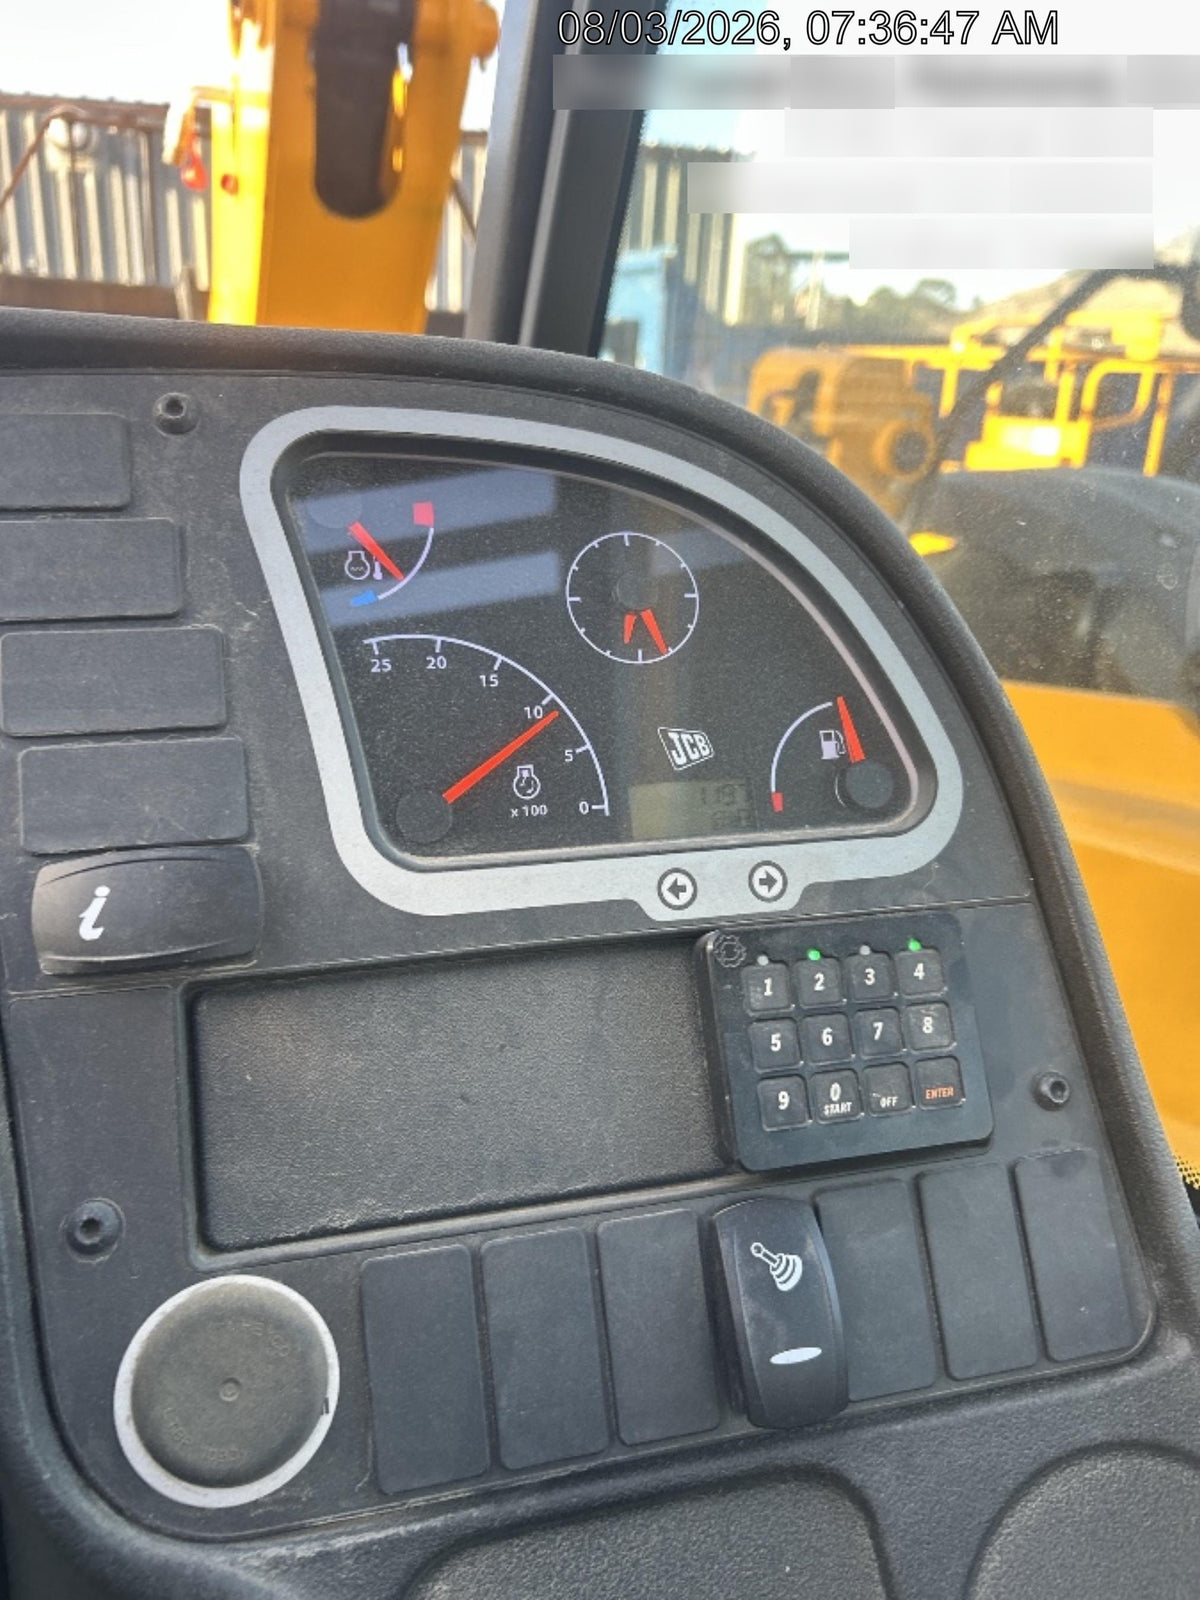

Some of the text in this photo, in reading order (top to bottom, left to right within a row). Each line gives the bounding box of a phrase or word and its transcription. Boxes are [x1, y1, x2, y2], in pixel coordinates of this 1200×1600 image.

[370, 658, 392, 673] 25
[426, 655, 447, 670] 20
[479, 673, 499, 688] 15
[524, 705, 543, 720] 10
[564, 749, 574, 762] 5
[670, 732, 709, 764] JCB
[524, 804, 548, 816] 100
[578, 801, 588, 815] 0
[864, 968, 876, 986] 3
[912, 962, 925, 980] 4
[763, 978, 773, 996] 1
[814, 973, 825, 992] 2
[873, 1022, 884, 1041] 7
[922, 1016, 934, 1034] 8
[770, 1033, 782, 1052] 5
[821, 1028, 833, 1047] 6
[778, 1091, 790, 1110] 9
[830, 1082, 841, 1101] 0
[925, 1086, 954, 1100] ENTER
[824, 1101, 852, 1115] START
[880, 1096, 898, 1108] OFF
